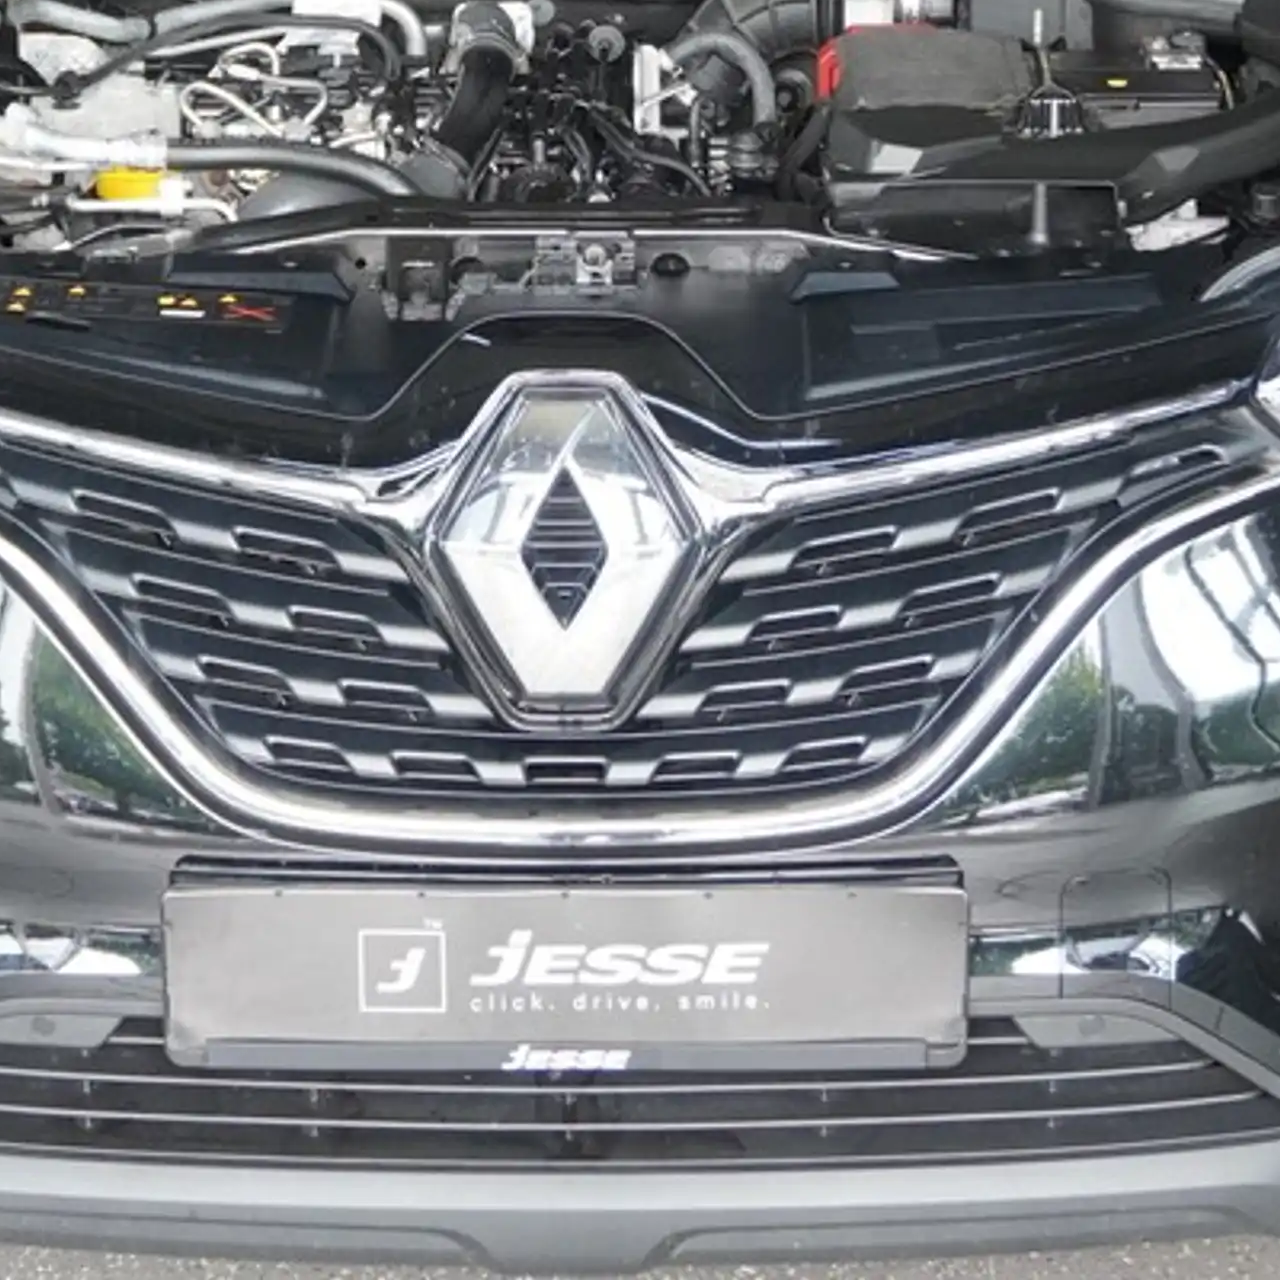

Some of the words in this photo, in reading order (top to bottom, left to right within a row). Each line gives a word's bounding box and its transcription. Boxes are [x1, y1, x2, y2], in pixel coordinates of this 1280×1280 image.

[469, 929, 770, 986] JESSE
[470, 992, 556, 1013] click.
[677, 989, 770, 1011] smile.
[501, 1043, 632, 1071] JESSE
